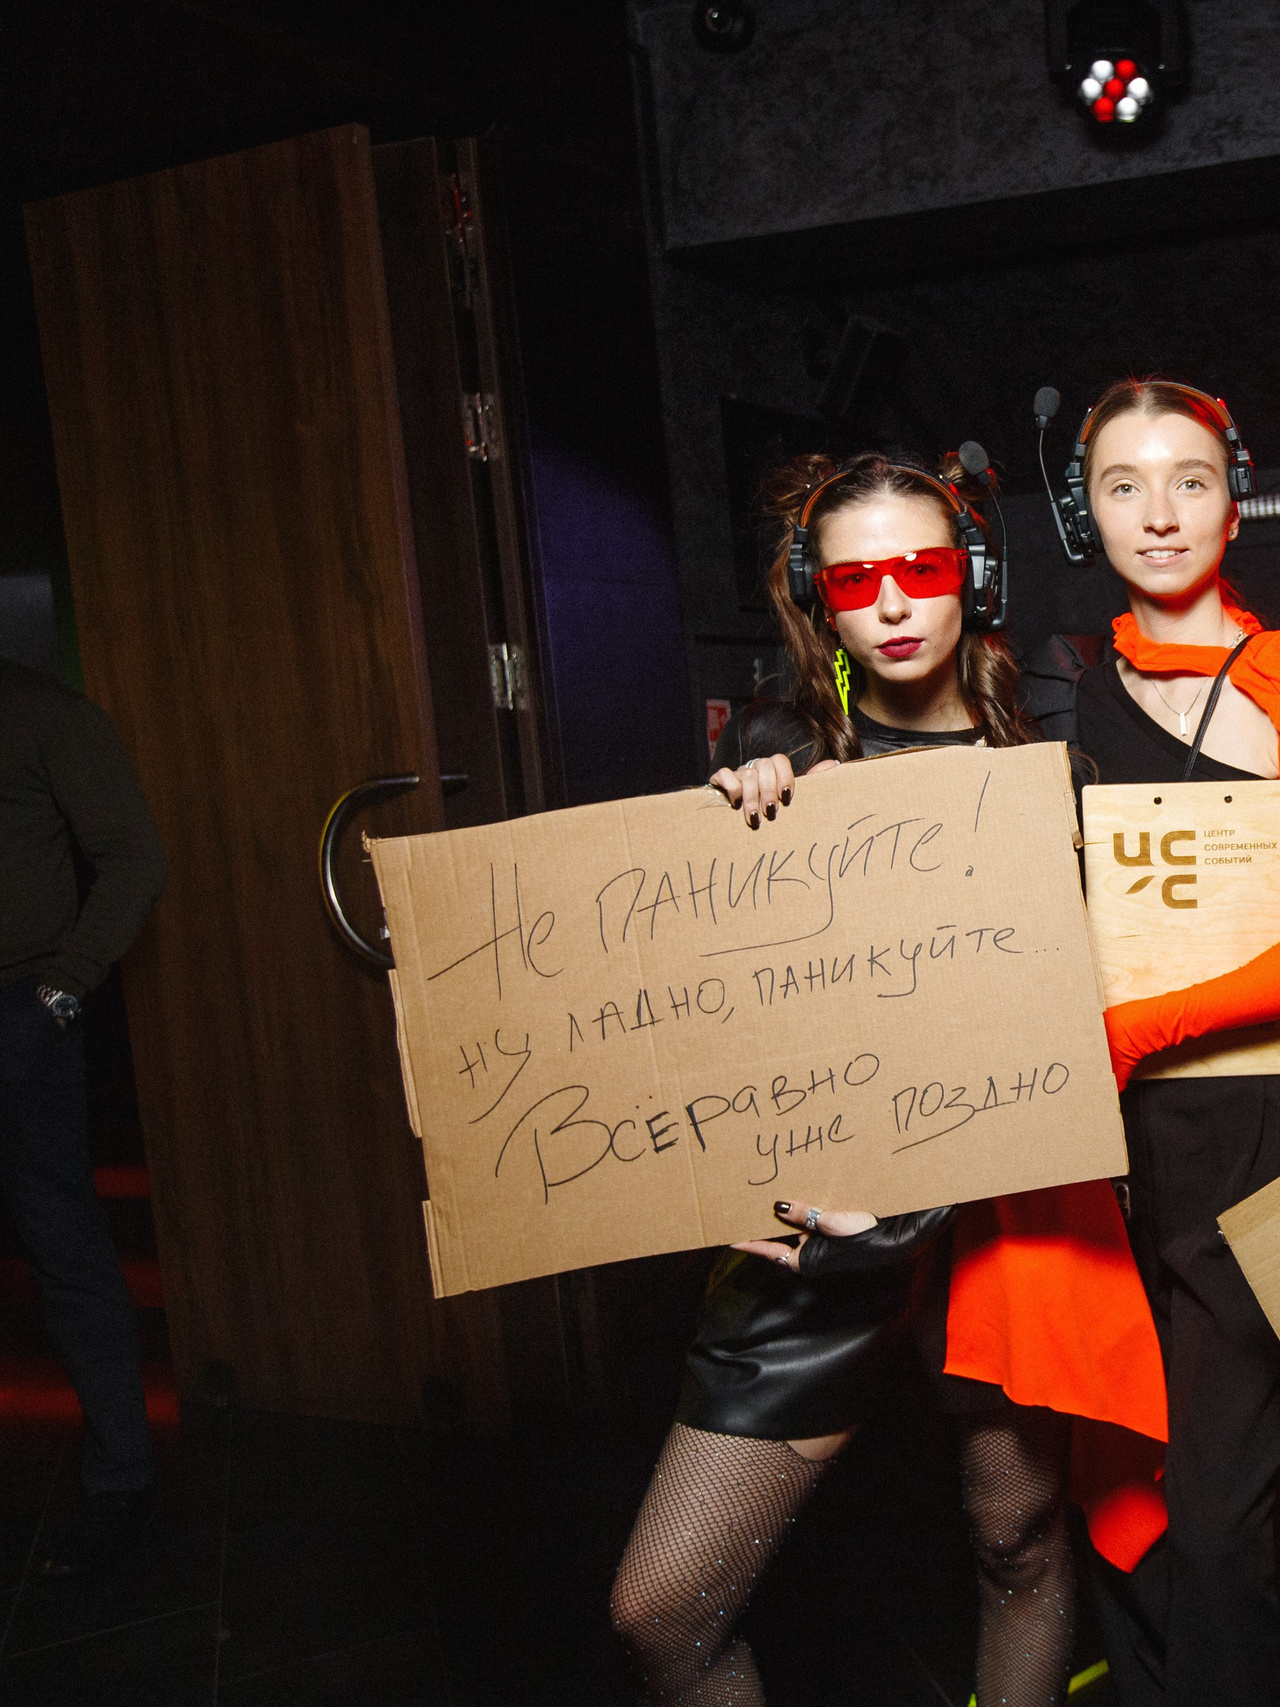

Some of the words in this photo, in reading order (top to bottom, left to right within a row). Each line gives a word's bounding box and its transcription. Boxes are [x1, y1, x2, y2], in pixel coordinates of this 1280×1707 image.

[1203, 829, 1236, 839] ЦЕНТР
[1203, 841, 1278, 852] СОВРЕМЕННЫХ
[1204, 854, 1253, 865] СОБЫТИЙ
